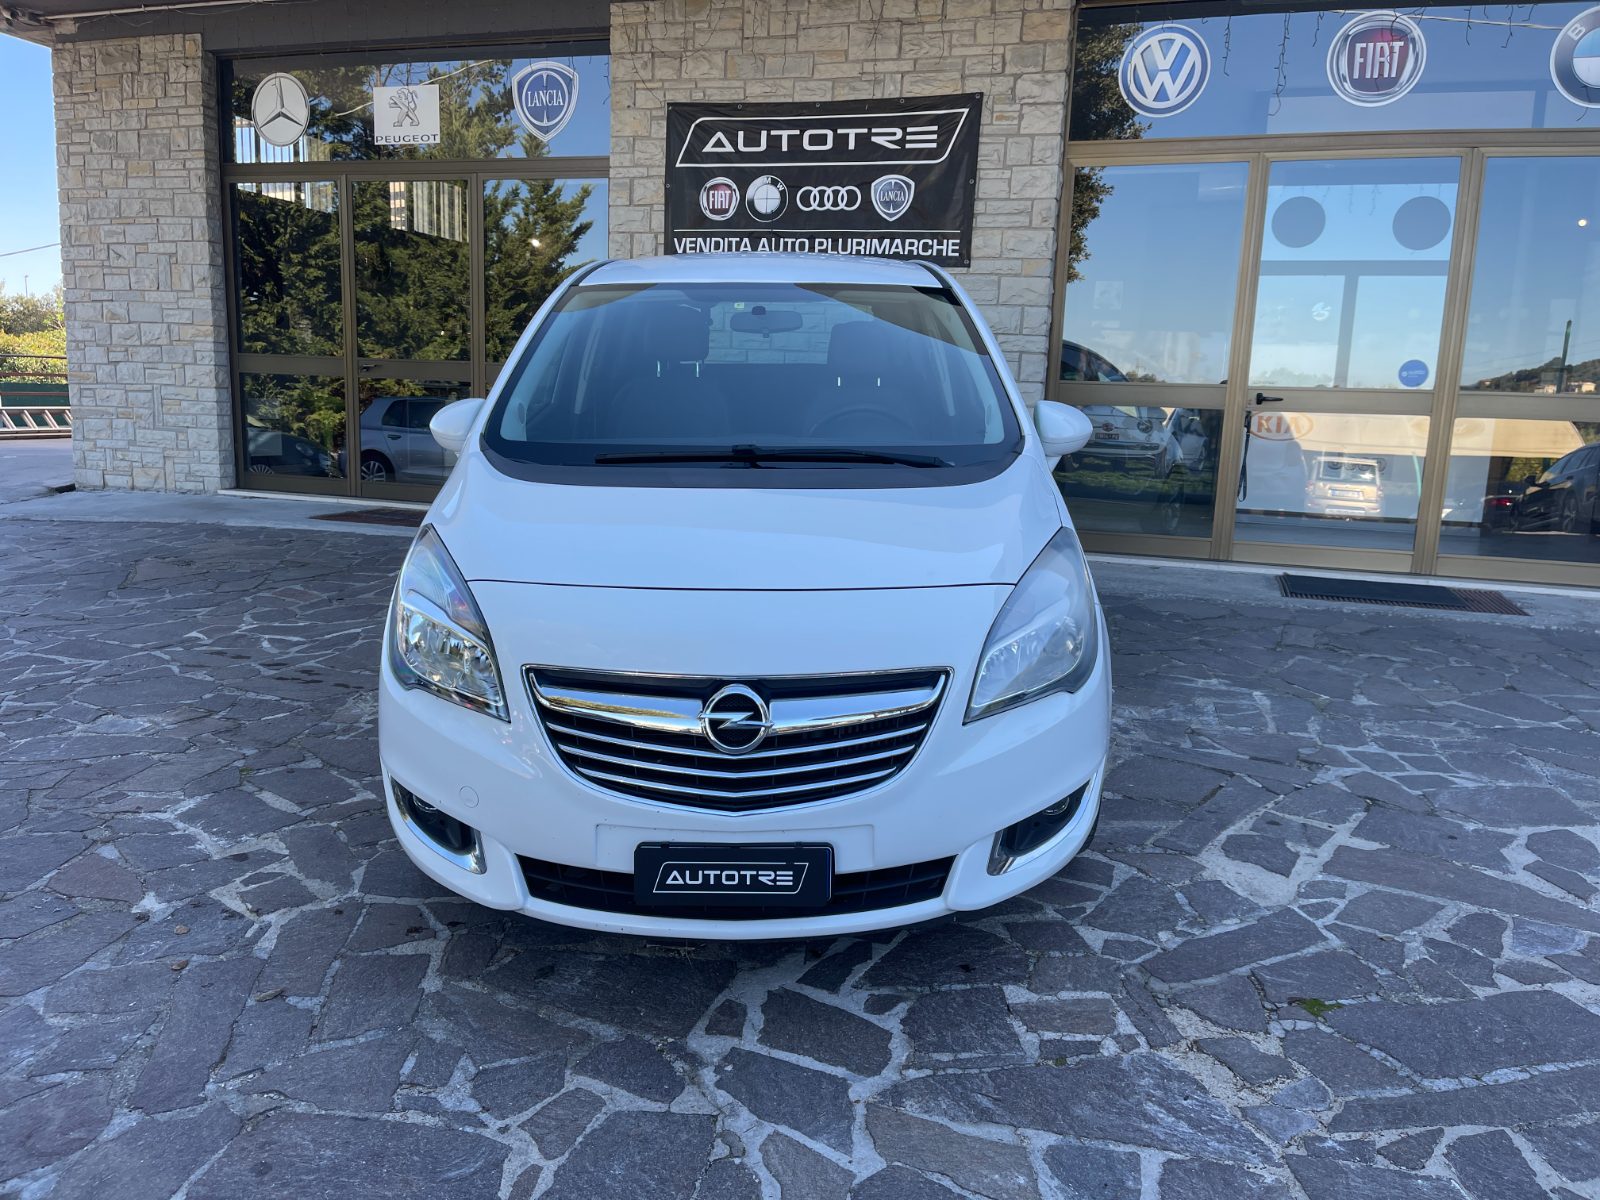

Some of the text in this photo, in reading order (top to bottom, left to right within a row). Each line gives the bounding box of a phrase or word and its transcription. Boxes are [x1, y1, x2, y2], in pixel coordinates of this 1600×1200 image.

[1353, 41, 1404, 80] FIAT
[527, 90, 565, 107] LANCIA
[375, 133, 438, 144] PEUGEOT
[702, 125, 938, 153] AUTOTRE
[709, 190, 731, 210] FIAT
[879, 190, 905, 202] LANCIA
[674, 237, 960, 257] VENDITA AUTO PLURIMARCHE
[666, 870, 794, 886] AUTOTRE
